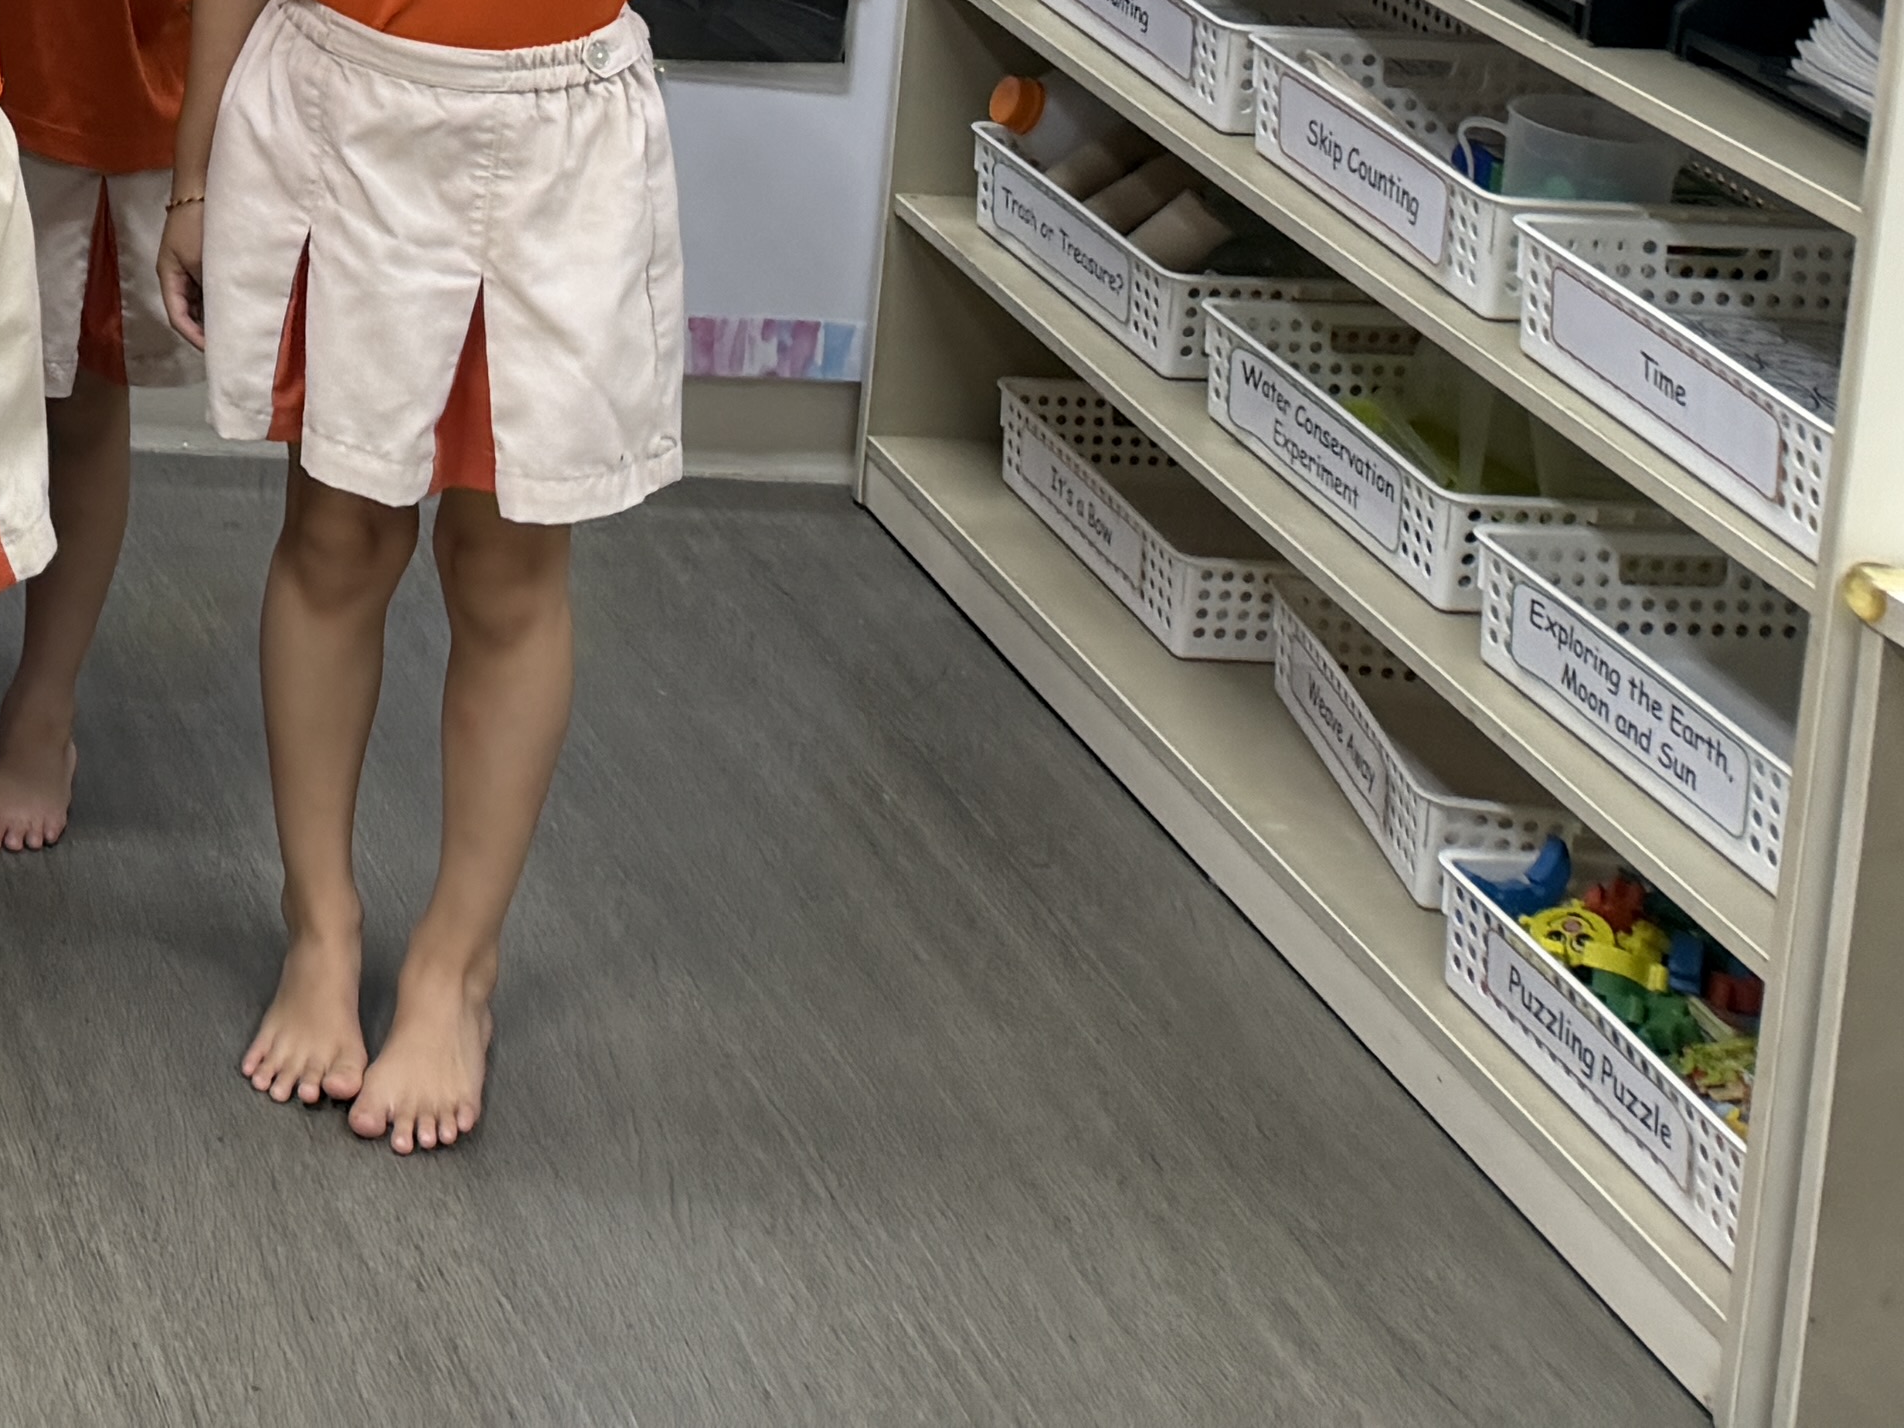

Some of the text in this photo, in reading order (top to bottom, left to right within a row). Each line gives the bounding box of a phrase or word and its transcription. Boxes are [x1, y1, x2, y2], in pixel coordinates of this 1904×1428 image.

[1306, 119, 1420, 226] Skip Counting
[1001, 185, 1124, 296] Trash or Treasure?
[1242, 359, 1395, 503] Water Conservation
[1640, 350, 1687, 407] Time
[1273, 416, 1359, 509] Experiment
[1308, 673, 1343, 744] Weave
[1529, 598, 1621, 695] Exploring
[1628, 674, 1663, 721] the
[1561, 662, 1697, 792] Moon and Sun
[1508, 963, 1672, 1150] Puzzling Puzzle
